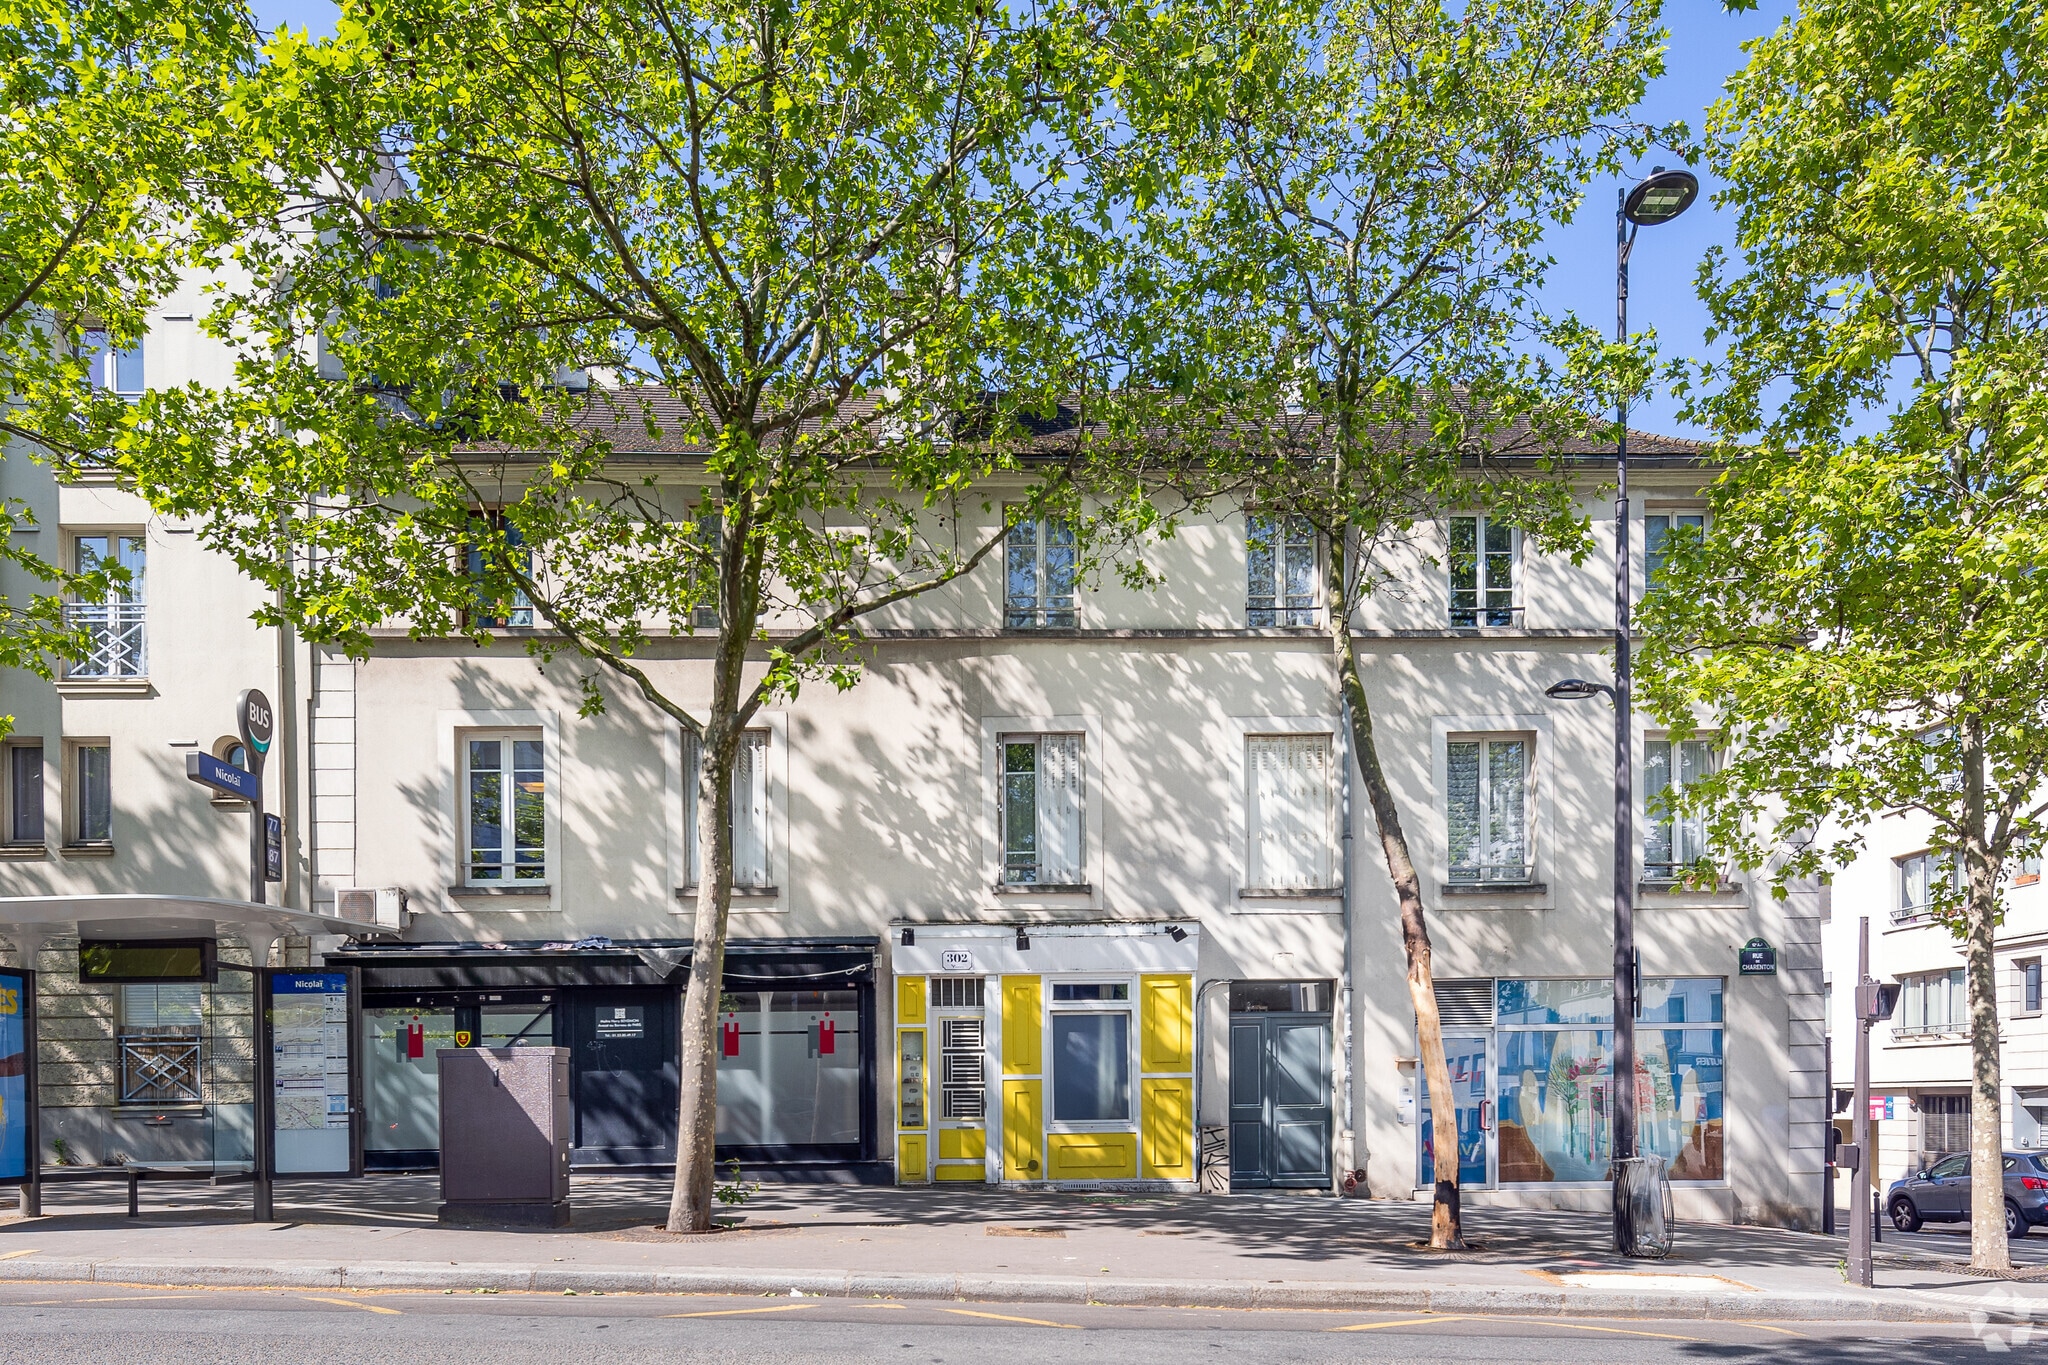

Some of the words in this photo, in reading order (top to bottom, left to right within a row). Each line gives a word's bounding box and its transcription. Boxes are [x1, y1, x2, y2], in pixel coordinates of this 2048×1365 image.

[249, 701, 270, 729] BUS
[215, 767, 241, 787] Nicolaï
[268, 817, 278, 831] 77
[268, 849, 279, 863] 87
[946, 953, 968, 963] 302
[295, 980, 324, 988] Nicolaï
